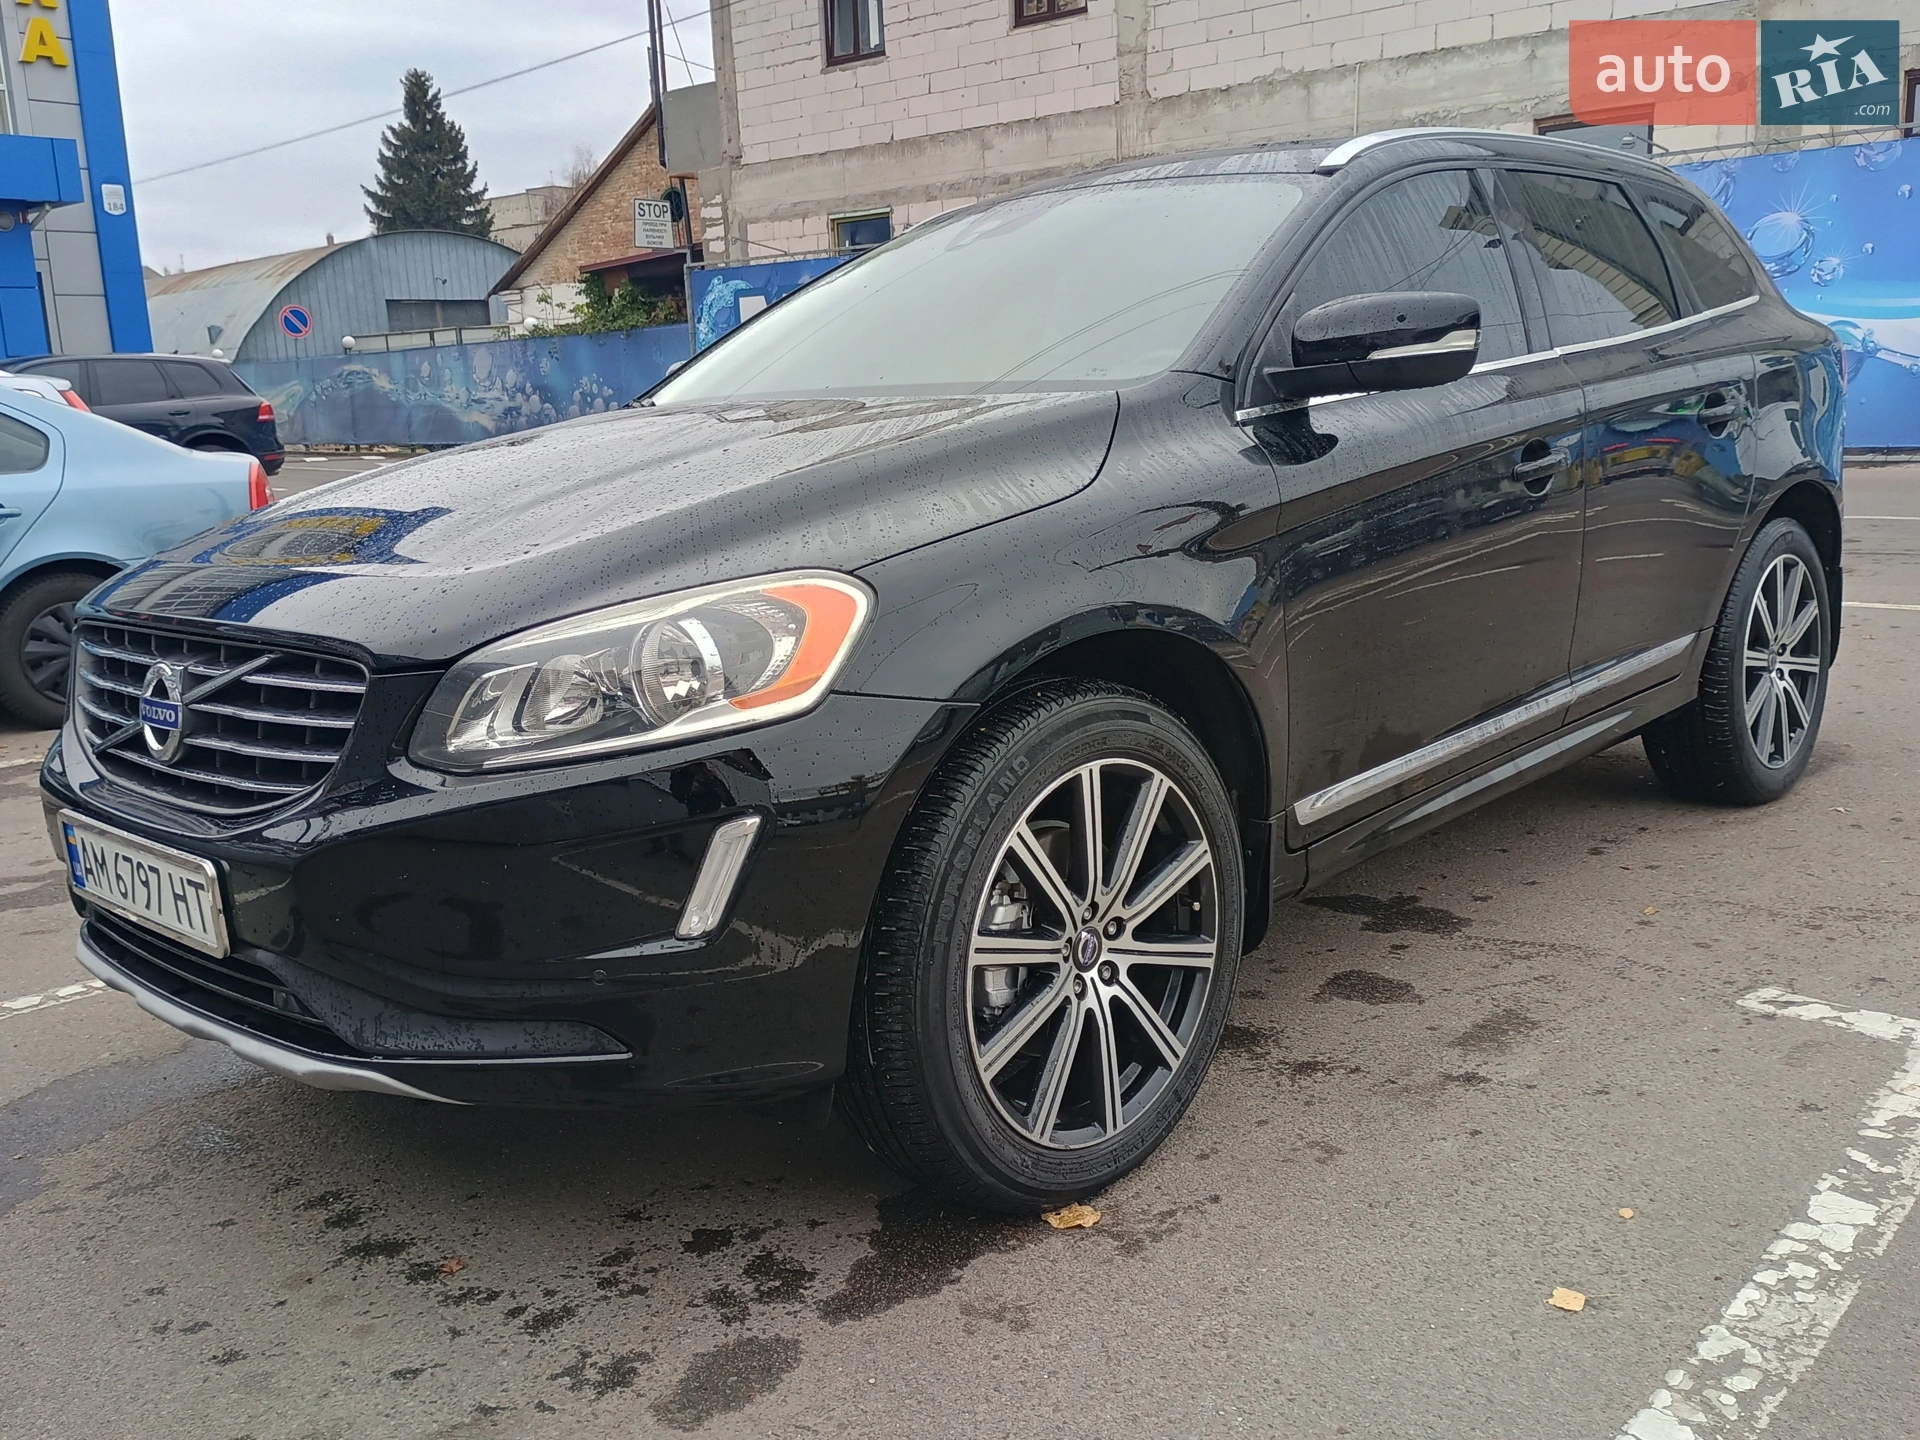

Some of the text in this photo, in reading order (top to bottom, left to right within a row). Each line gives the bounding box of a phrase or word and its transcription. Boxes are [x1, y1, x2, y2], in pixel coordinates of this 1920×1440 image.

[638, 202, 669, 219] STOP
[141, 703, 176, 723] VOLVO
[81, 836, 208, 935] AM 6797 HT
